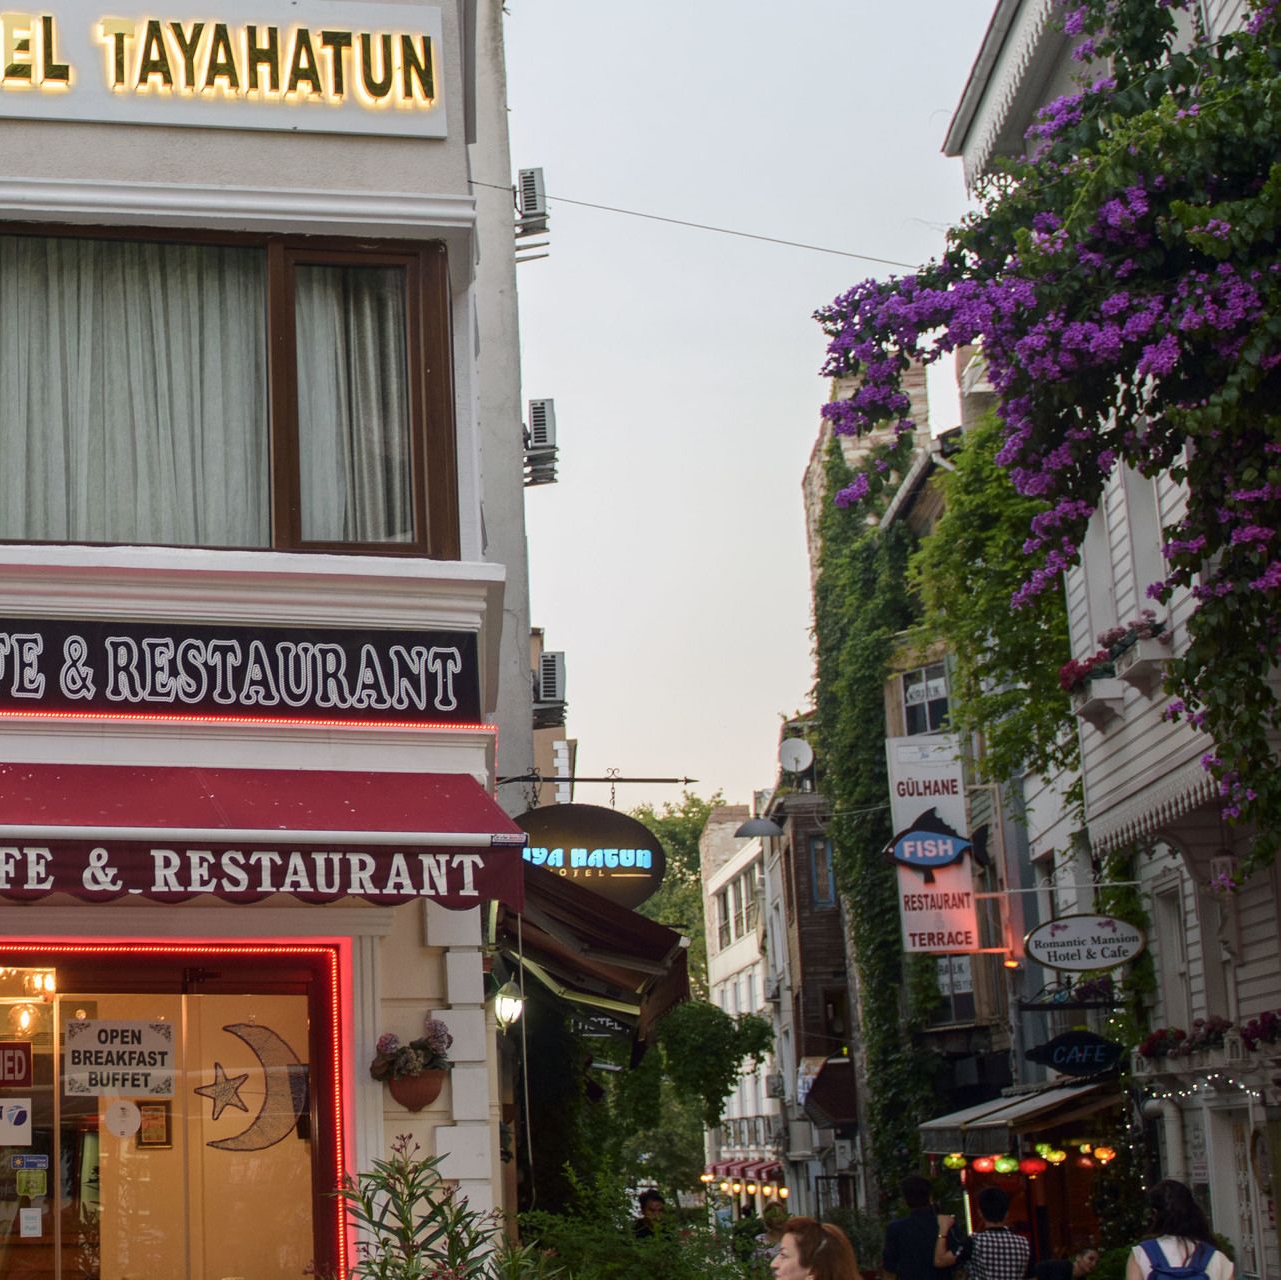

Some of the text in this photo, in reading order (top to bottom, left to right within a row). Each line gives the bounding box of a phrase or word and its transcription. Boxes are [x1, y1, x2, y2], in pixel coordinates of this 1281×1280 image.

[102, 18, 434, 102] TAYAHATUN
[60, 635, 95, 700] &
[106, 636, 461, 711] RESTAURANT
[896, 777, 958, 798] GÜLHANE
[903, 839, 954, 859] FISH
[82, 847, 122, 893] &
[150, 849, 485, 897] RESTAURANT
[550, 869, 605, 878] OTEL
[903, 893, 972, 912] RESTAURANT
[909, 931, 973, 948] TERRACE
[1034, 933, 1140, 950] Romantic Mansion
[1046, 945, 1130, 963] Hotel & Cafe
[97, 1028, 143, 1045] OPEN
[71, 1050, 168, 1067] BREAKFAST
[1052, 1044, 1107, 1065] CAFE
[88, 1071, 152, 1089] BUFFET
